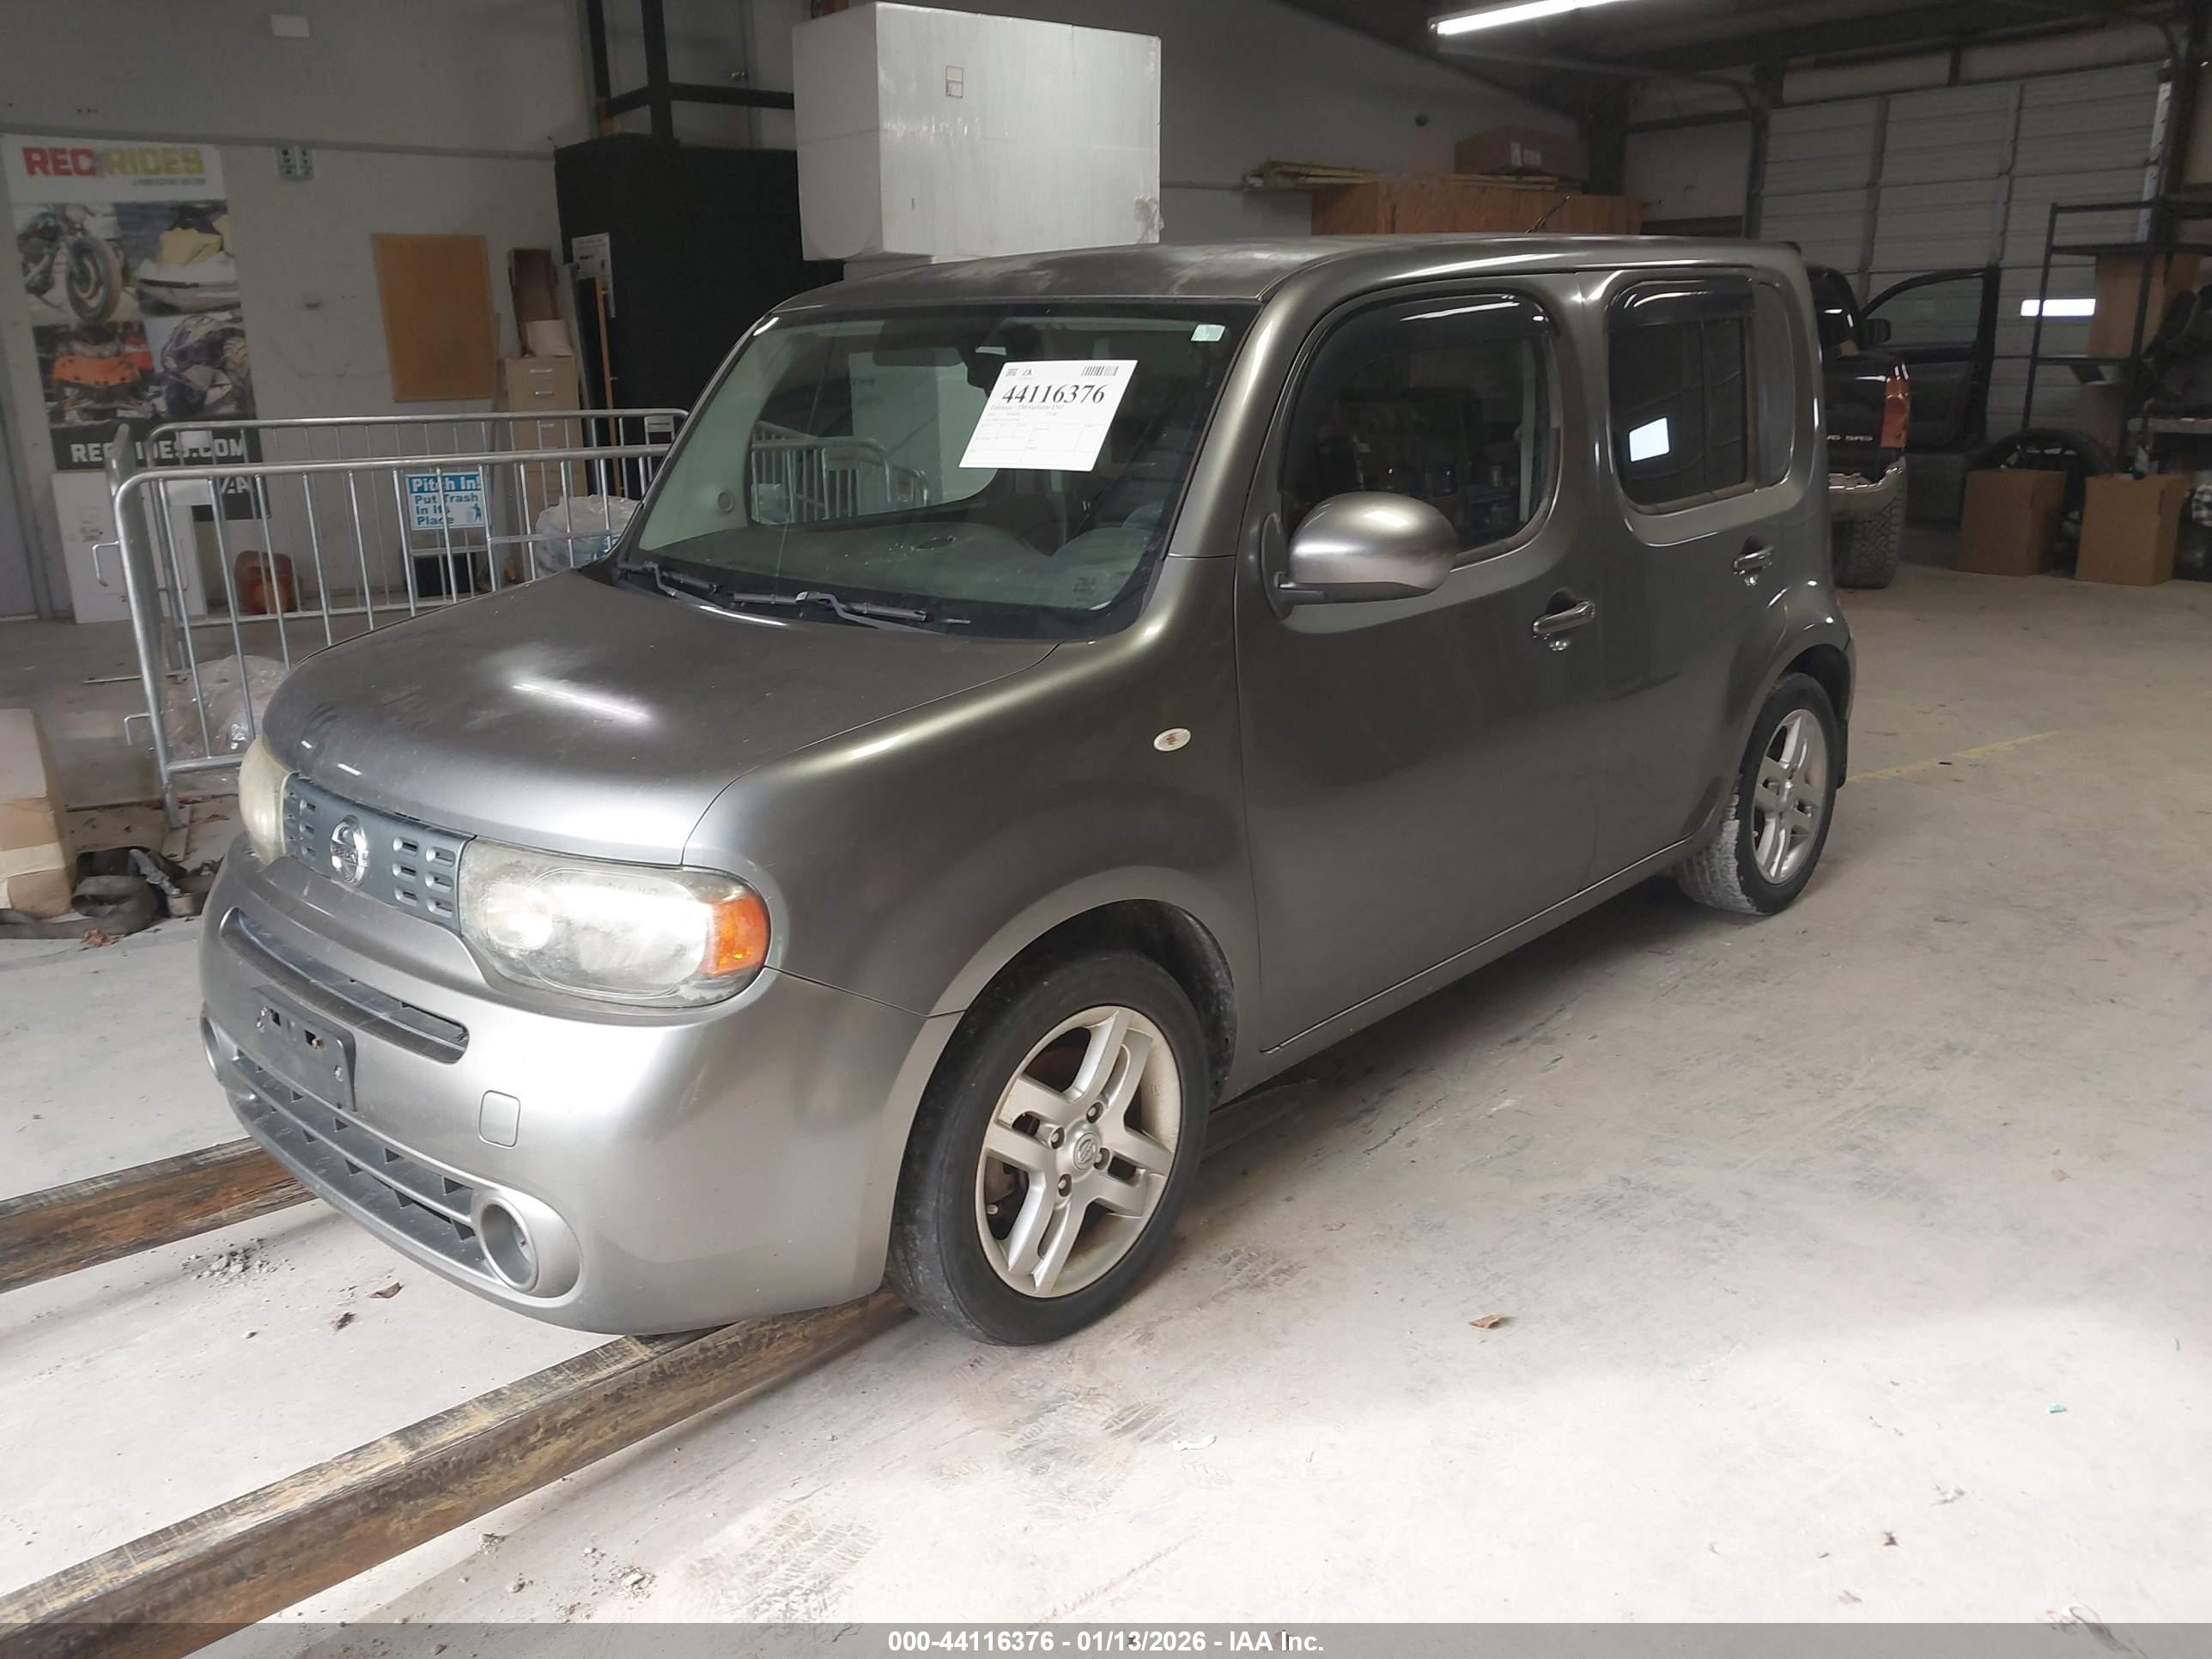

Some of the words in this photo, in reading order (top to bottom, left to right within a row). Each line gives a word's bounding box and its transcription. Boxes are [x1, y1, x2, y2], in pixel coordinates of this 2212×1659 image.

[22, 147, 96, 176] REC
[101, 147, 205, 175] RIDES
[1002, 384, 1109, 404] 44116376
[413, 477, 456, 492] Pitch
[415, 495, 438, 505] Put
[444, 493, 479, 502] Trash
[416, 506, 428, 515] In
[417, 516, 454, 526] Place
